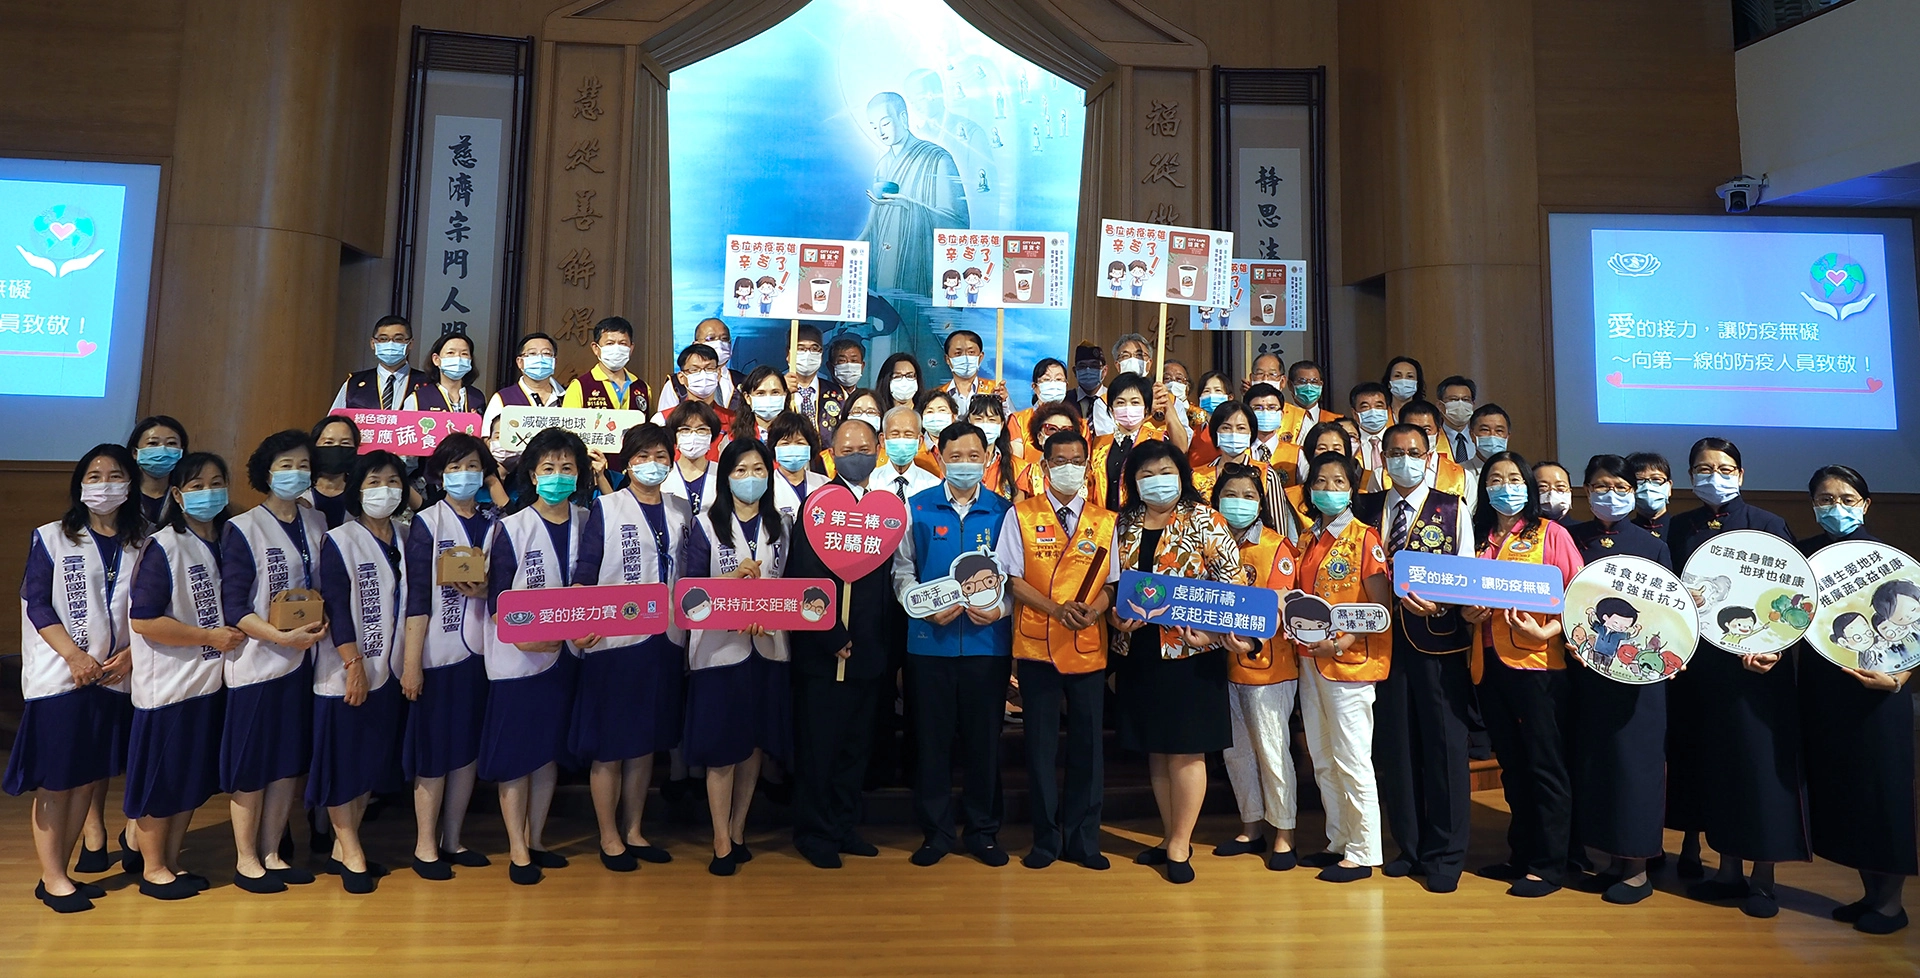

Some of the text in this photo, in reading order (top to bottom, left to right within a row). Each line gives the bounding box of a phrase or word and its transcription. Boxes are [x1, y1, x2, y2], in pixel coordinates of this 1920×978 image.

[937, 233, 1000, 246] 各位防疫英雄
[1105, 224, 1166, 241] 各位防疫英雄
[730, 240, 797, 253] 各位防疫英雄
[1607, 312, 1820, 341] 愛的接力，讓防疫無礙
[354, 413, 398, 425] 綠色奇蹟
[522, 415, 586, 429] 減碳愛地球
[360, 423, 437, 450] 響應蔬食
[830, 509, 880, 530] 第三棒
[620, 524, 641, 585] 臺東縣國際蘭馨
[824, 531, 882, 555] 我驕傲
[1710, 544, 1788, 570] 吃蔬食身體好
[1409, 565, 1551, 596] 愛的接力，讓防疫無礙
[1604, 562, 1679, 593] 蔬食好處多
[1739, 564, 1806, 588] 地球也健康
[1819, 556, 1905, 608] 推廣蔬食益健康
[713, 597, 798, 613] 保持社交距離
[910, 585, 942, 606] 勤洗手
[932, 589, 961, 609] 戴口罩
[1611, 579, 1686, 611] 增強抵抗力
[539, 605, 618, 624] 愛的接力賽
[1171, 605, 1266, 632] 疫起走過難關
